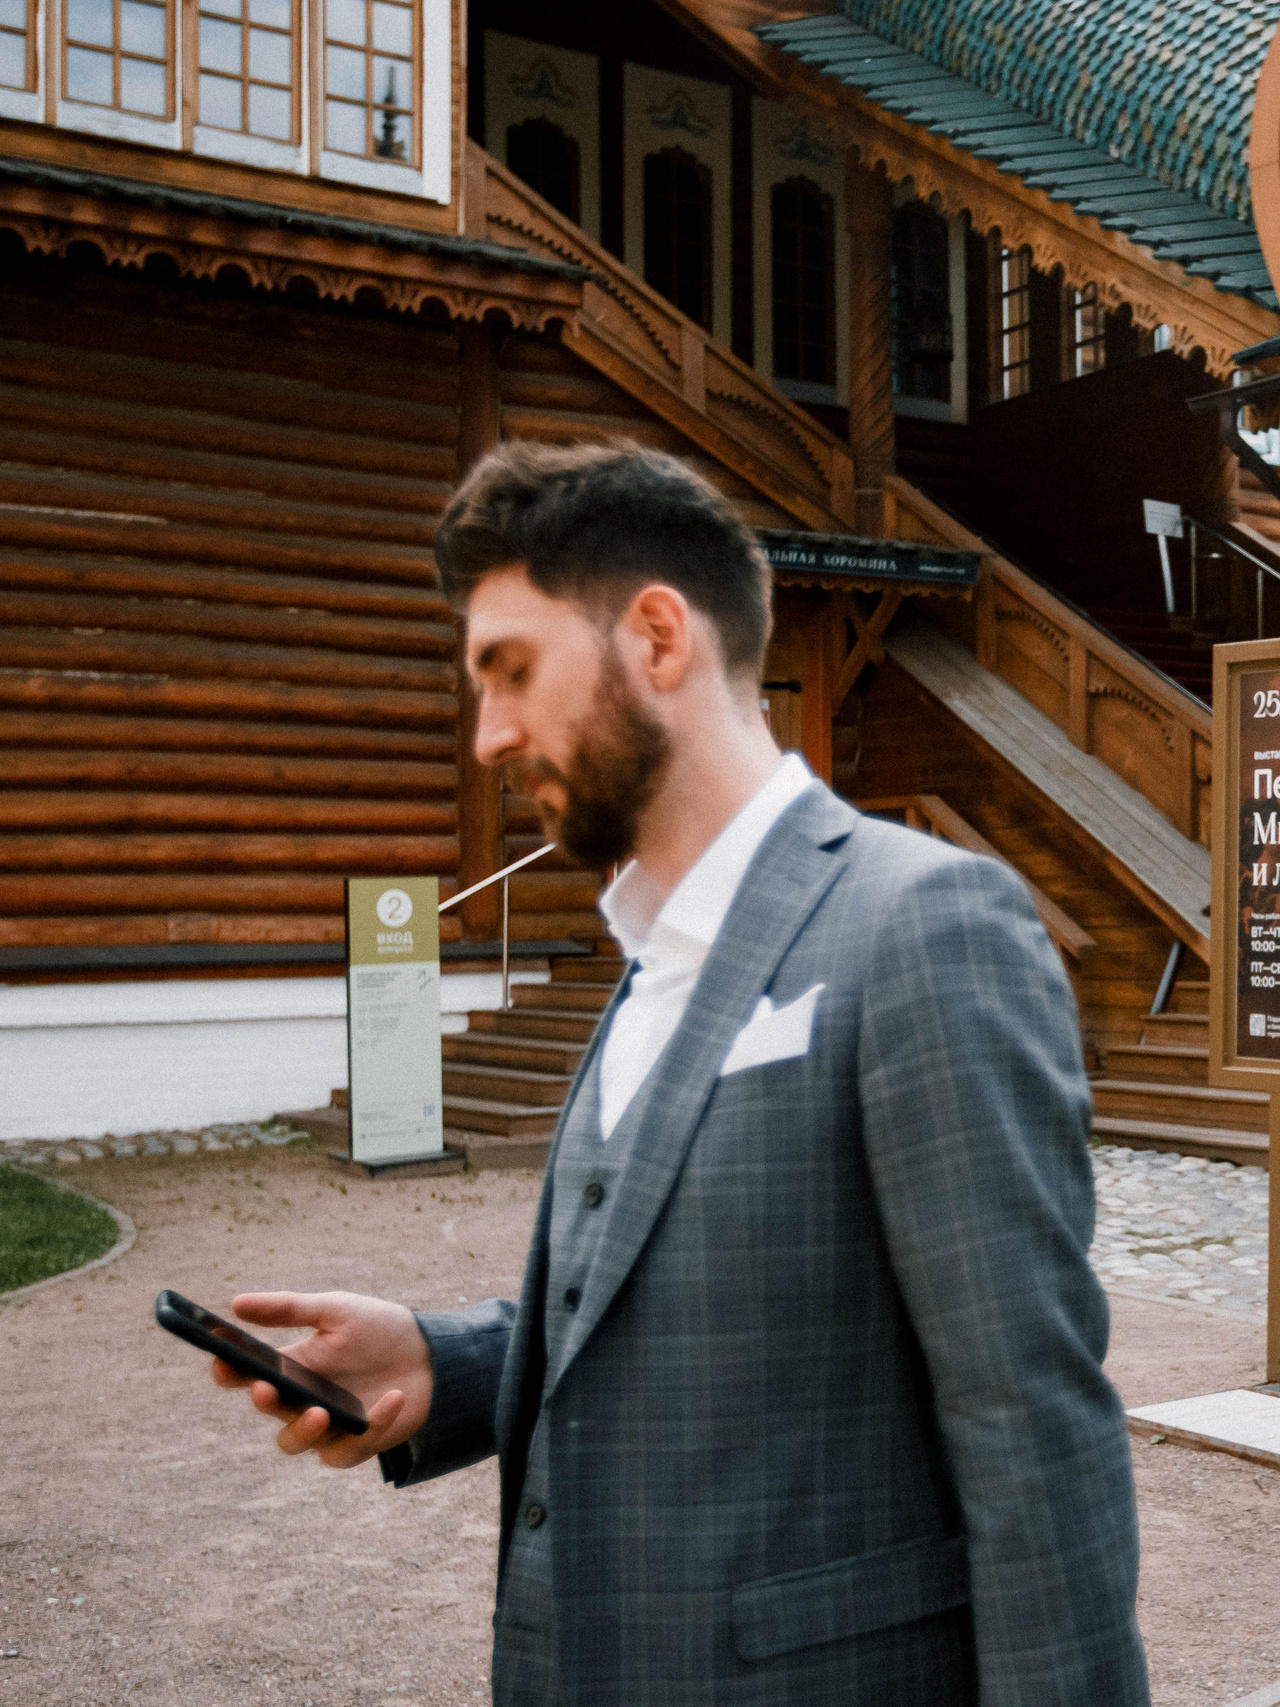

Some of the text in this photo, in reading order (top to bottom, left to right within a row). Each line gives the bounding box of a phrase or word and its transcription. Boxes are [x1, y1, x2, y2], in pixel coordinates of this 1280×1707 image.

[823, 554, 897, 572] ХОРОМИНА
[1252, 862, 1268, 887] и
[386, 896, 403, 920] 2
